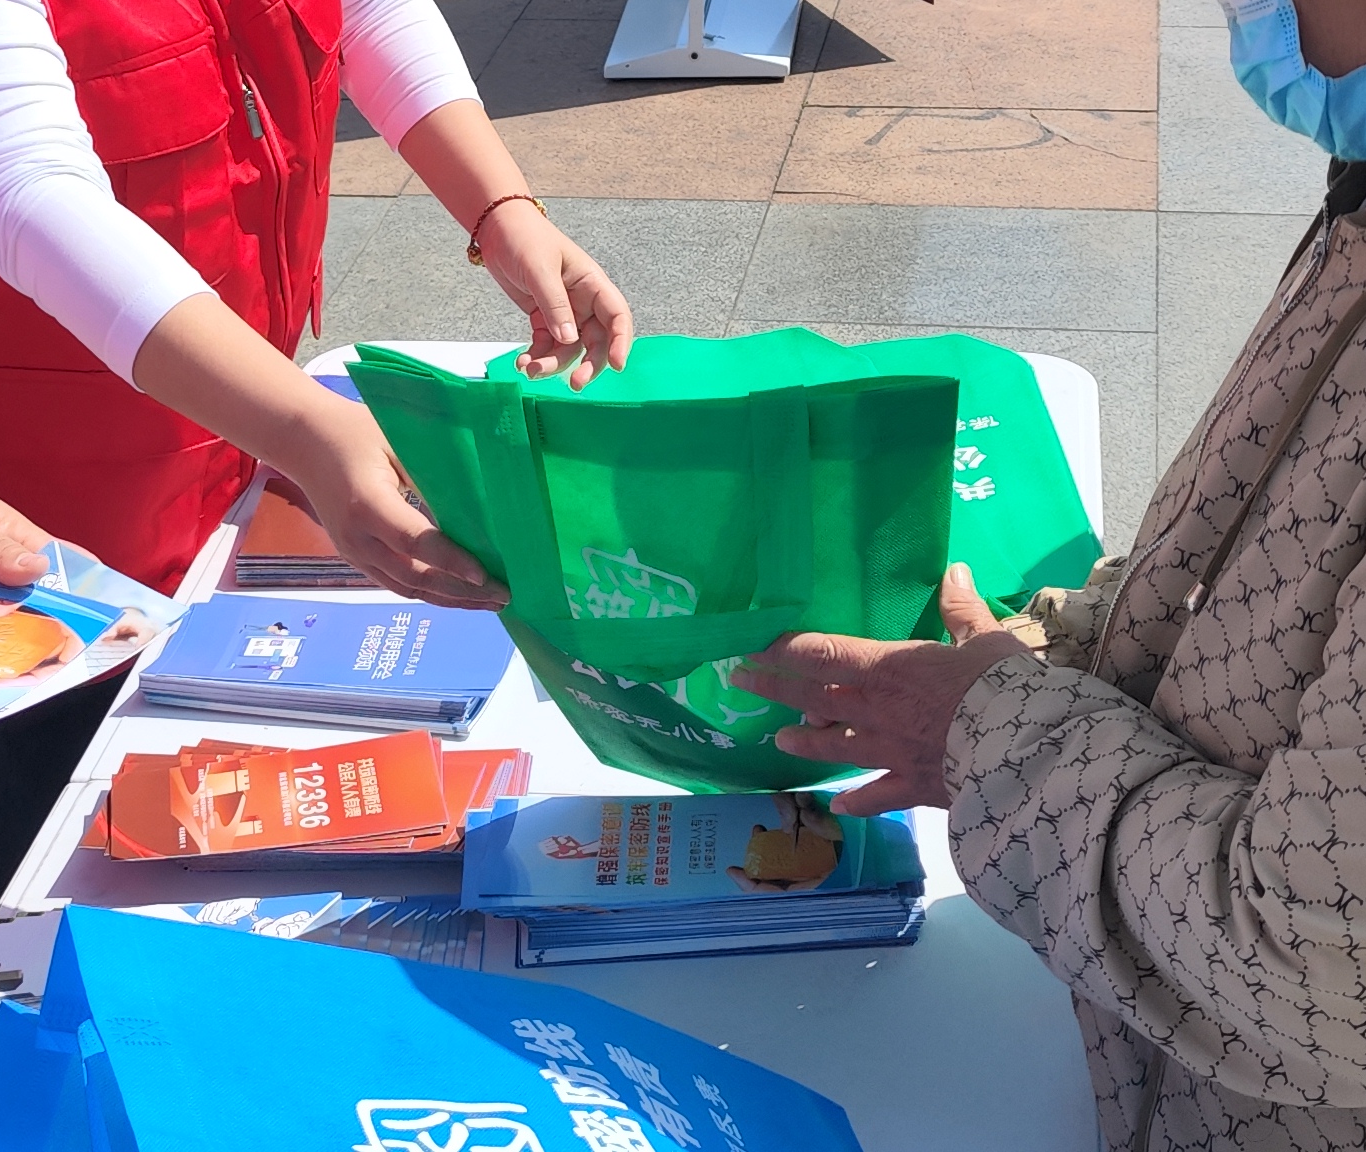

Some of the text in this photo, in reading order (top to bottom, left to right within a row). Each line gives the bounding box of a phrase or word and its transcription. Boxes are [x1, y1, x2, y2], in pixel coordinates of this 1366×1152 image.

[352, 624, 386, 671] 保密须知
[371, 611, 411, 680] 手机使用安全
[293, 761, 332, 829] 12336
[337, 761, 363, 818] 公民人人有责
[596, 802, 623, 886] 增强保密意识
[625, 802, 652, 886] 筑牢保密防线
[654, 801, 672, 886] 保密知识宣传手册
